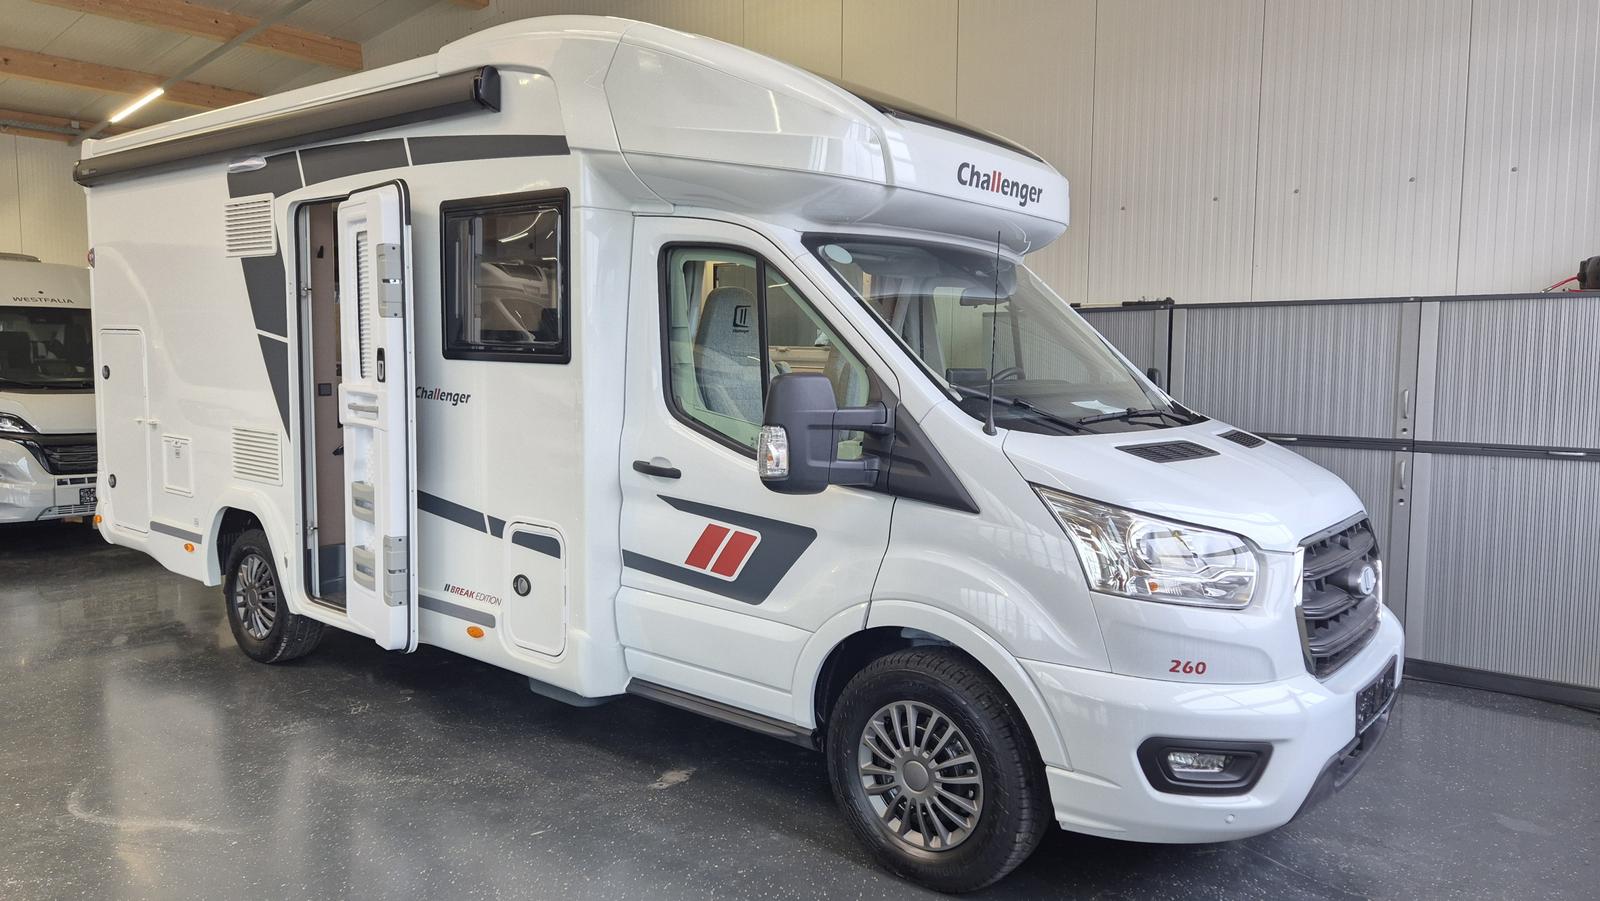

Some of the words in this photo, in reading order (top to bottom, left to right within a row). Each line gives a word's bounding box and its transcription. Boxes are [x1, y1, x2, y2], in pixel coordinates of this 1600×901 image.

[957, 162, 1043, 207] Challenger
[12, 296, 74, 304] WESTFALIA
[415, 386, 471, 407] Challenger
[450, 585, 475, 599] BREAK
[475, 592, 502, 606] EDITION
[1169, 659, 1207, 675] 260
